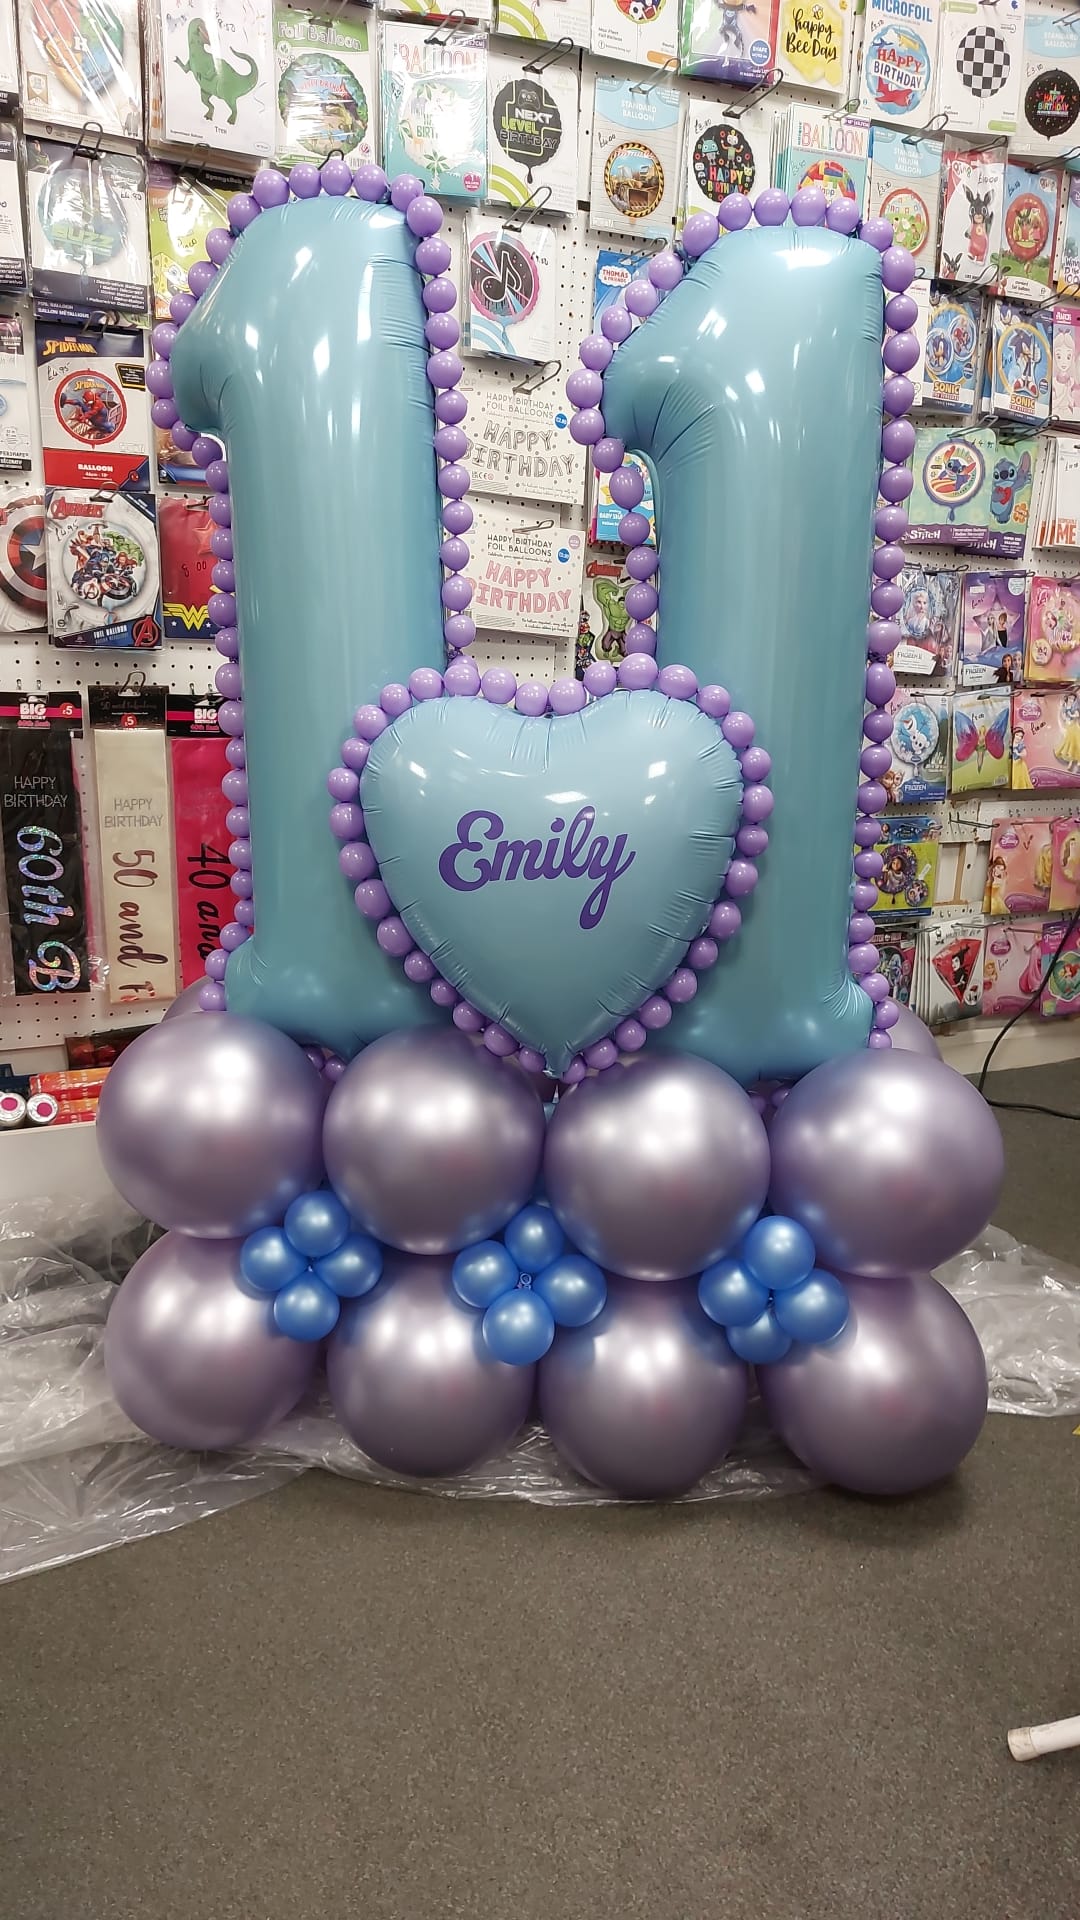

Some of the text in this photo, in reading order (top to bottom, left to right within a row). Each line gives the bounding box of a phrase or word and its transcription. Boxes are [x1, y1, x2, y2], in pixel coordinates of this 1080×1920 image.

[793, 7, 834, 44] happy
[278, 21, 361, 50] Foil Balloon
[786, 31, 837, 63] Bee Day
[877, 48, 923, 73] HAPPY
[874, 61, 923, 89] BIRTHDAY
[621, 100, 657, 113] STANDARD
[622, 110, 655, 121] BALLOON
[515, 107, 553, 125] NEXT
[501, 116, 540, 135] LEVEL
[499, 130, 558, 149] BIRTHDAY
[801, 122, 864, 155] BALLOON
[710, 165, 743, 183] HAPPY
[603, 269, 629, 278] THOMAS
[933, 381, 961, 391] SONIC
[486, 401, 554, 419] FOIL BALLOONS
[487, 392, 554, 411] HAPPY BIRTHDAY
[1010, 394, 1035, 408] SONIC
[484, 420, 553, 451] HAPPY
[78, 463, 113, 472] BALLOON
[487, 534, 553, 548] HAPPY BIRTHDAY
[487, 542, 505, 551] FOIL
[509, 546, 552, 557] BALLOONS
[485, 560, 551, 589] HAPPY
[19, 703, 47, 715] BIG
[62, 705, 73, 717] £5
[194, 709, 218, 720] BIG
[123, 715, 135, 727] £5
[14, 775, 57, 789] HAPPY
[904, 784, 927, 792] FROZEN
[4, 794, 69, 809] BIRTHDAY
[113, 798, 153, 811] HAPPY
[104, 815, 163, 828] BIRTHDAY
[111, 848, 159, 889] 50
[187, 843, 231, 889] 40
[438, 805, 636, 930] Emily
[17, 825, 75, 926] 60th
[116, 900, 169, 969] and
